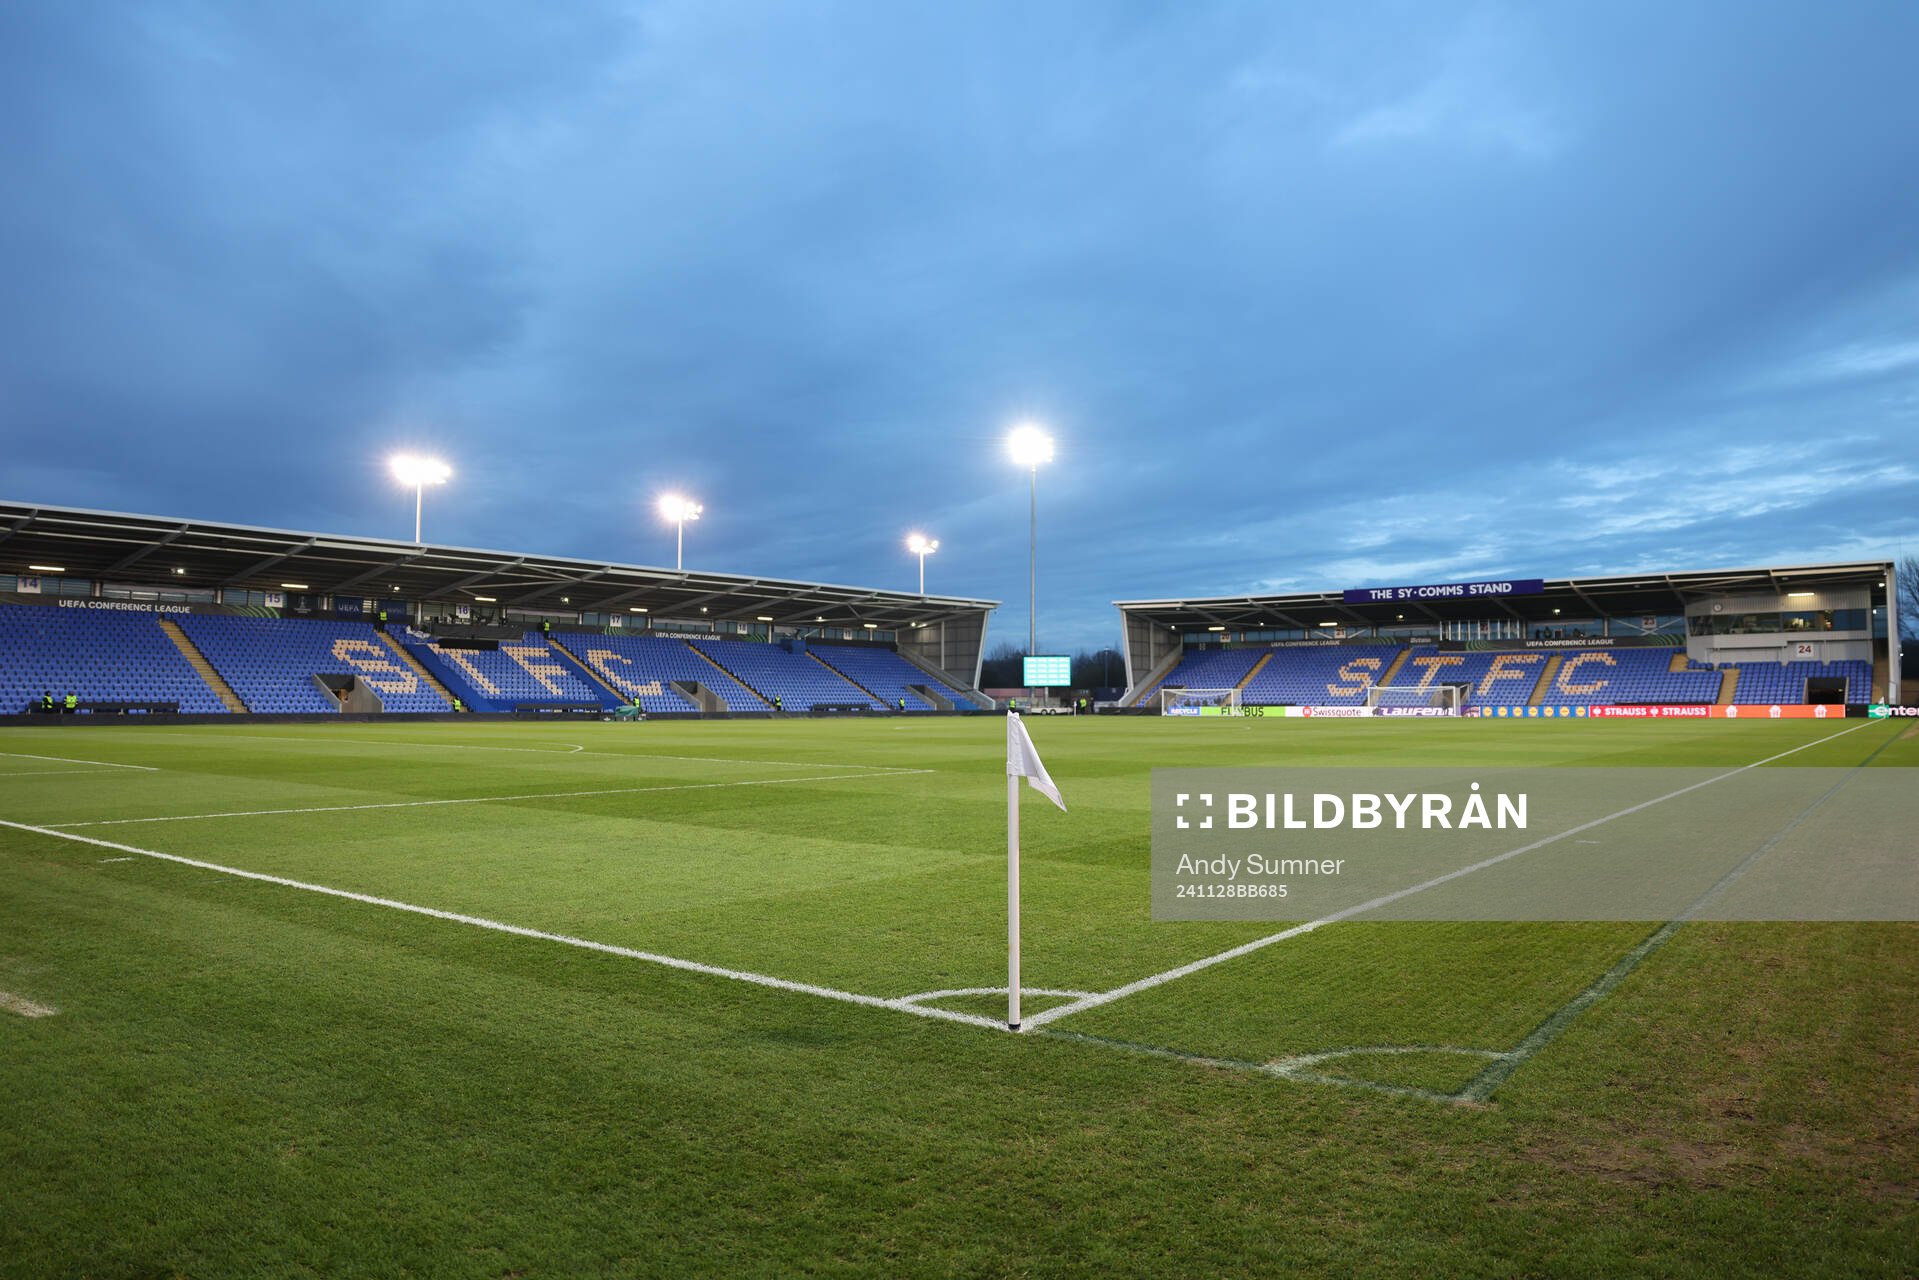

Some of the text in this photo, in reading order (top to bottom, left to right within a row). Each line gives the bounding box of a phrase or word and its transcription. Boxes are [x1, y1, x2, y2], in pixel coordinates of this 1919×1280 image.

[1370, 590, 1393, 599] THE
[1469, 583, 1512, 594] STAND
[269, 594, 281, 603] 15
[59, 600, 191, 614] UEFA CONFERENCE LEAGUE
[338, 604, 360, 612] UEFA
[459, 605, 468, 614] 16
[1798, 645, 1811, 653] 24
[1313, 706, 1361, 717] Swissquote
[1605, 707, 1706, 715] STRAUSS STRAUSS
